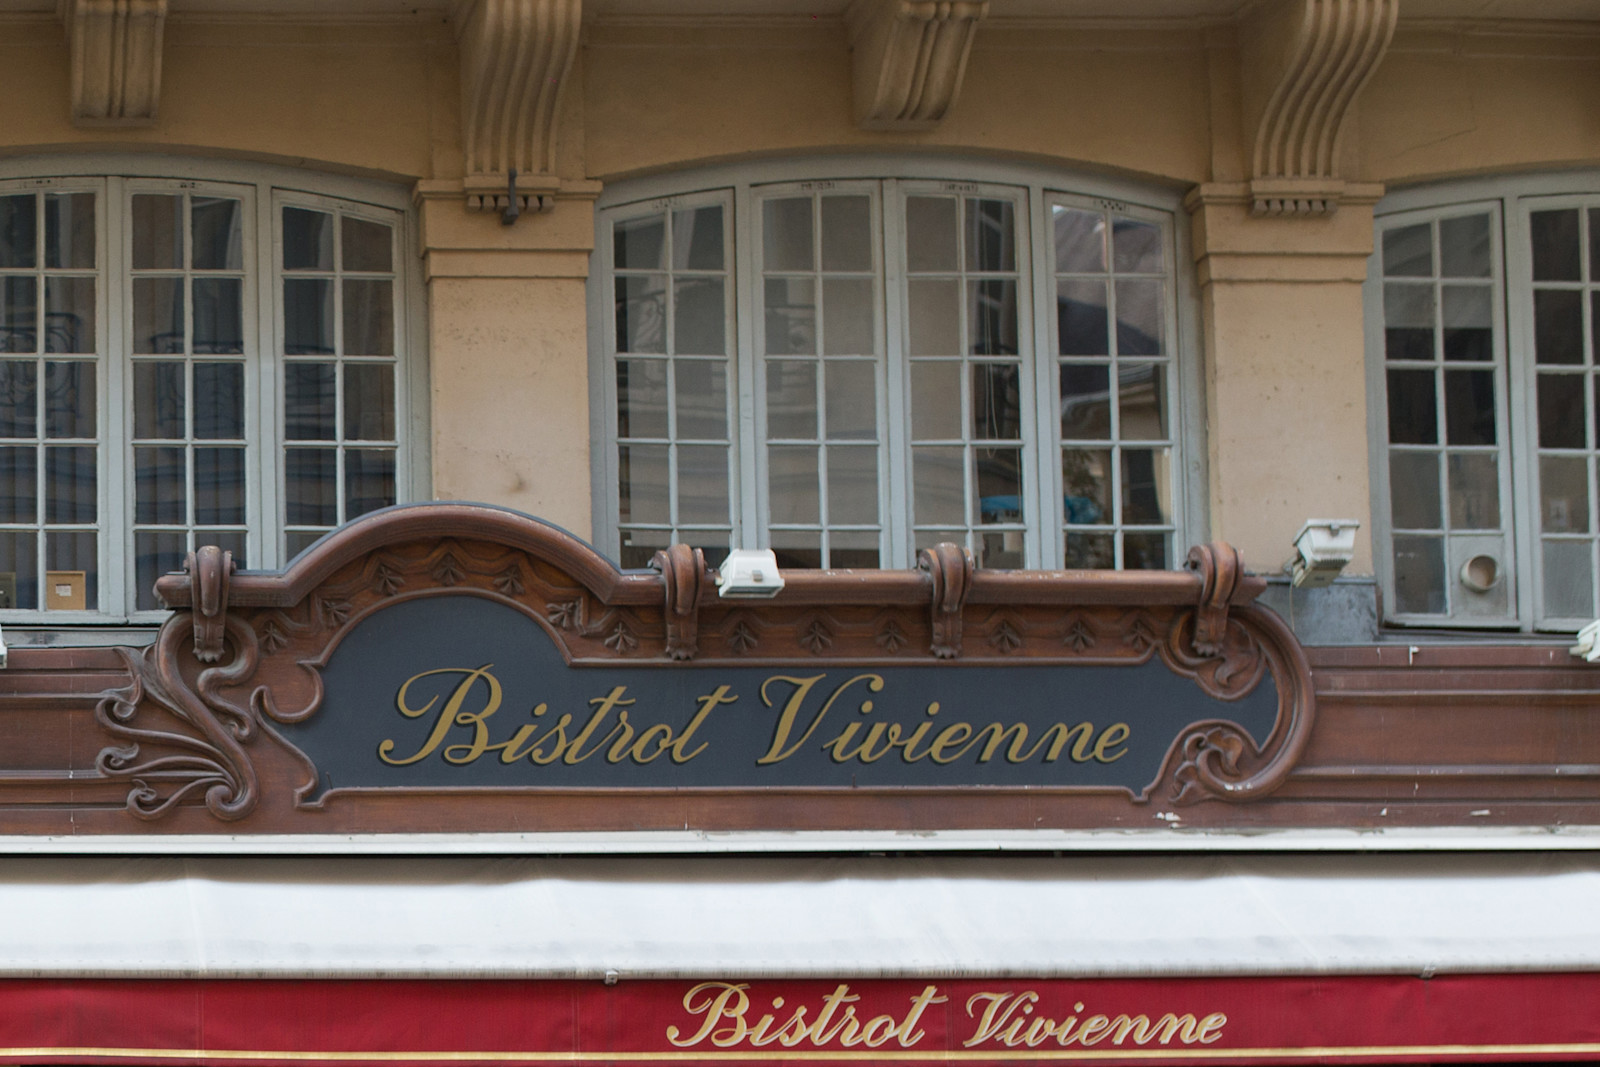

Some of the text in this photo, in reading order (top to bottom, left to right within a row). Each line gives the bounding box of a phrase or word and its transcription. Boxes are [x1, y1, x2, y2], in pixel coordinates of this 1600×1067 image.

[378, 663, 1131, 767] Bistrot Vivienne
[667, 982, 1228, 1048] Bistrot Vivienne
